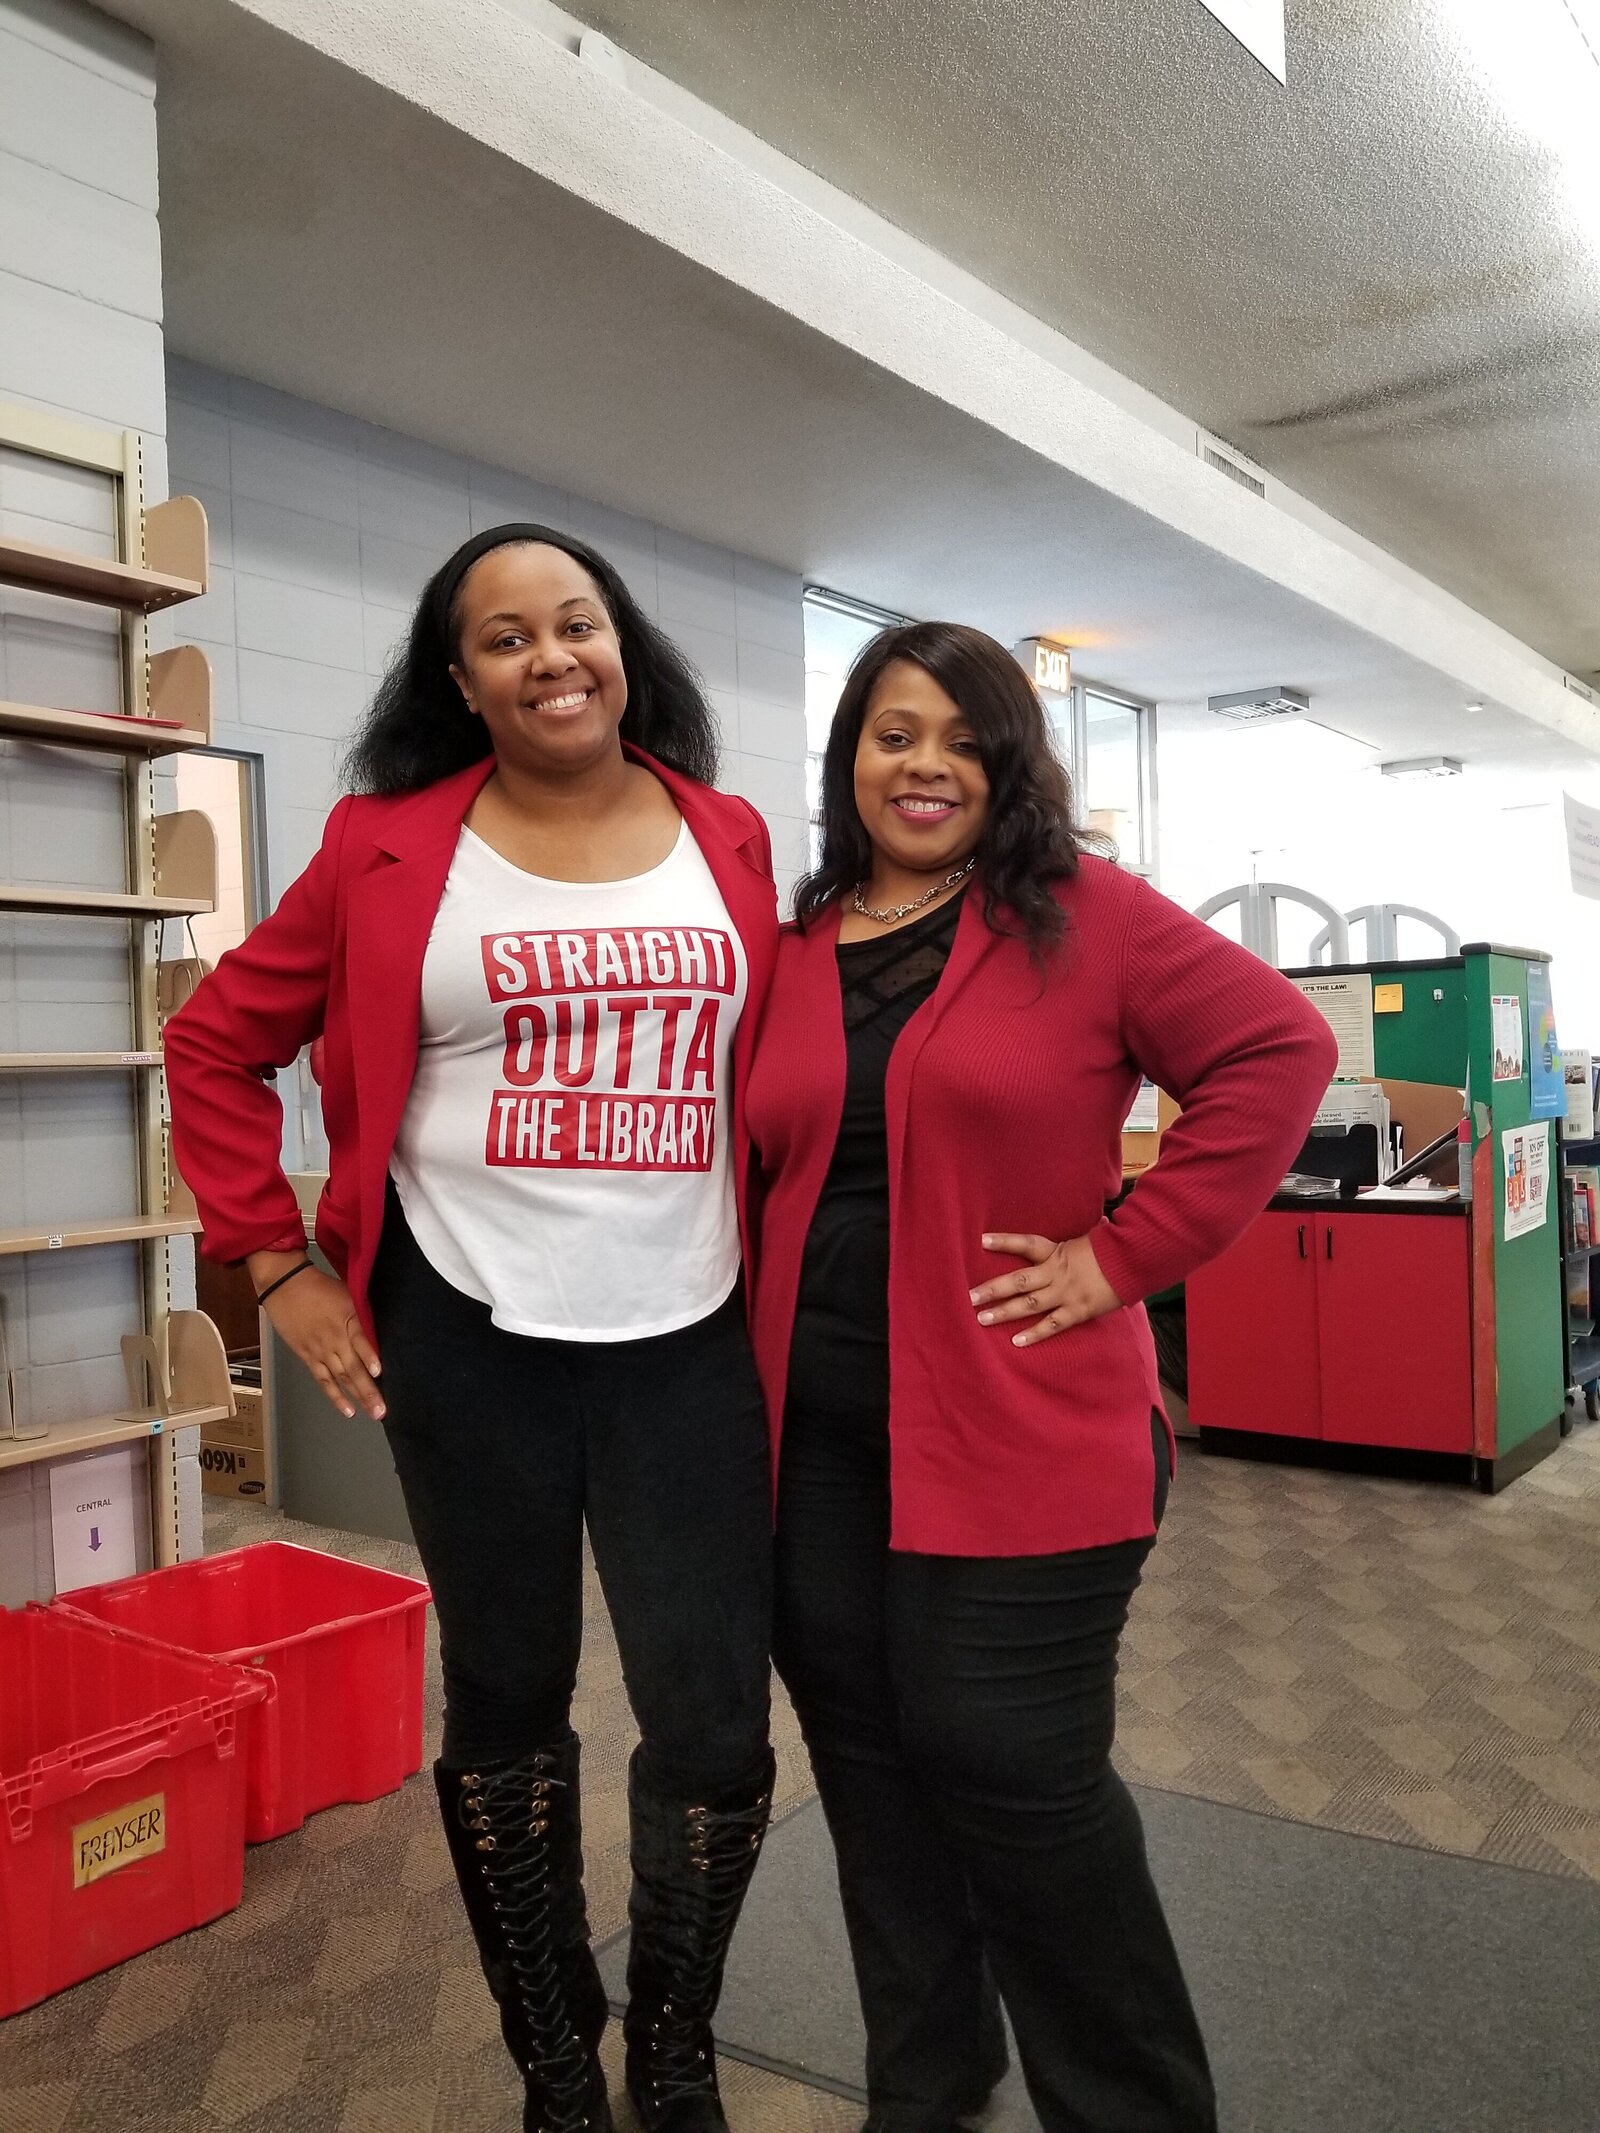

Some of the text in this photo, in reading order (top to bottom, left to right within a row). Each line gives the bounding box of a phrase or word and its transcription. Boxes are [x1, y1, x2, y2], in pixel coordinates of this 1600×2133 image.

[1035, 646, 1068, 693] EXIT
[492, 930, 726, 993] STRAIGHT
[503, 996, 721, 1092] OUTTA
[497, 1098, 714, 1164] THE LIBRARY
[76, 1498, 113, 1513] CENTRAL
[80, 1808, 161, 1870] FRAYSER
